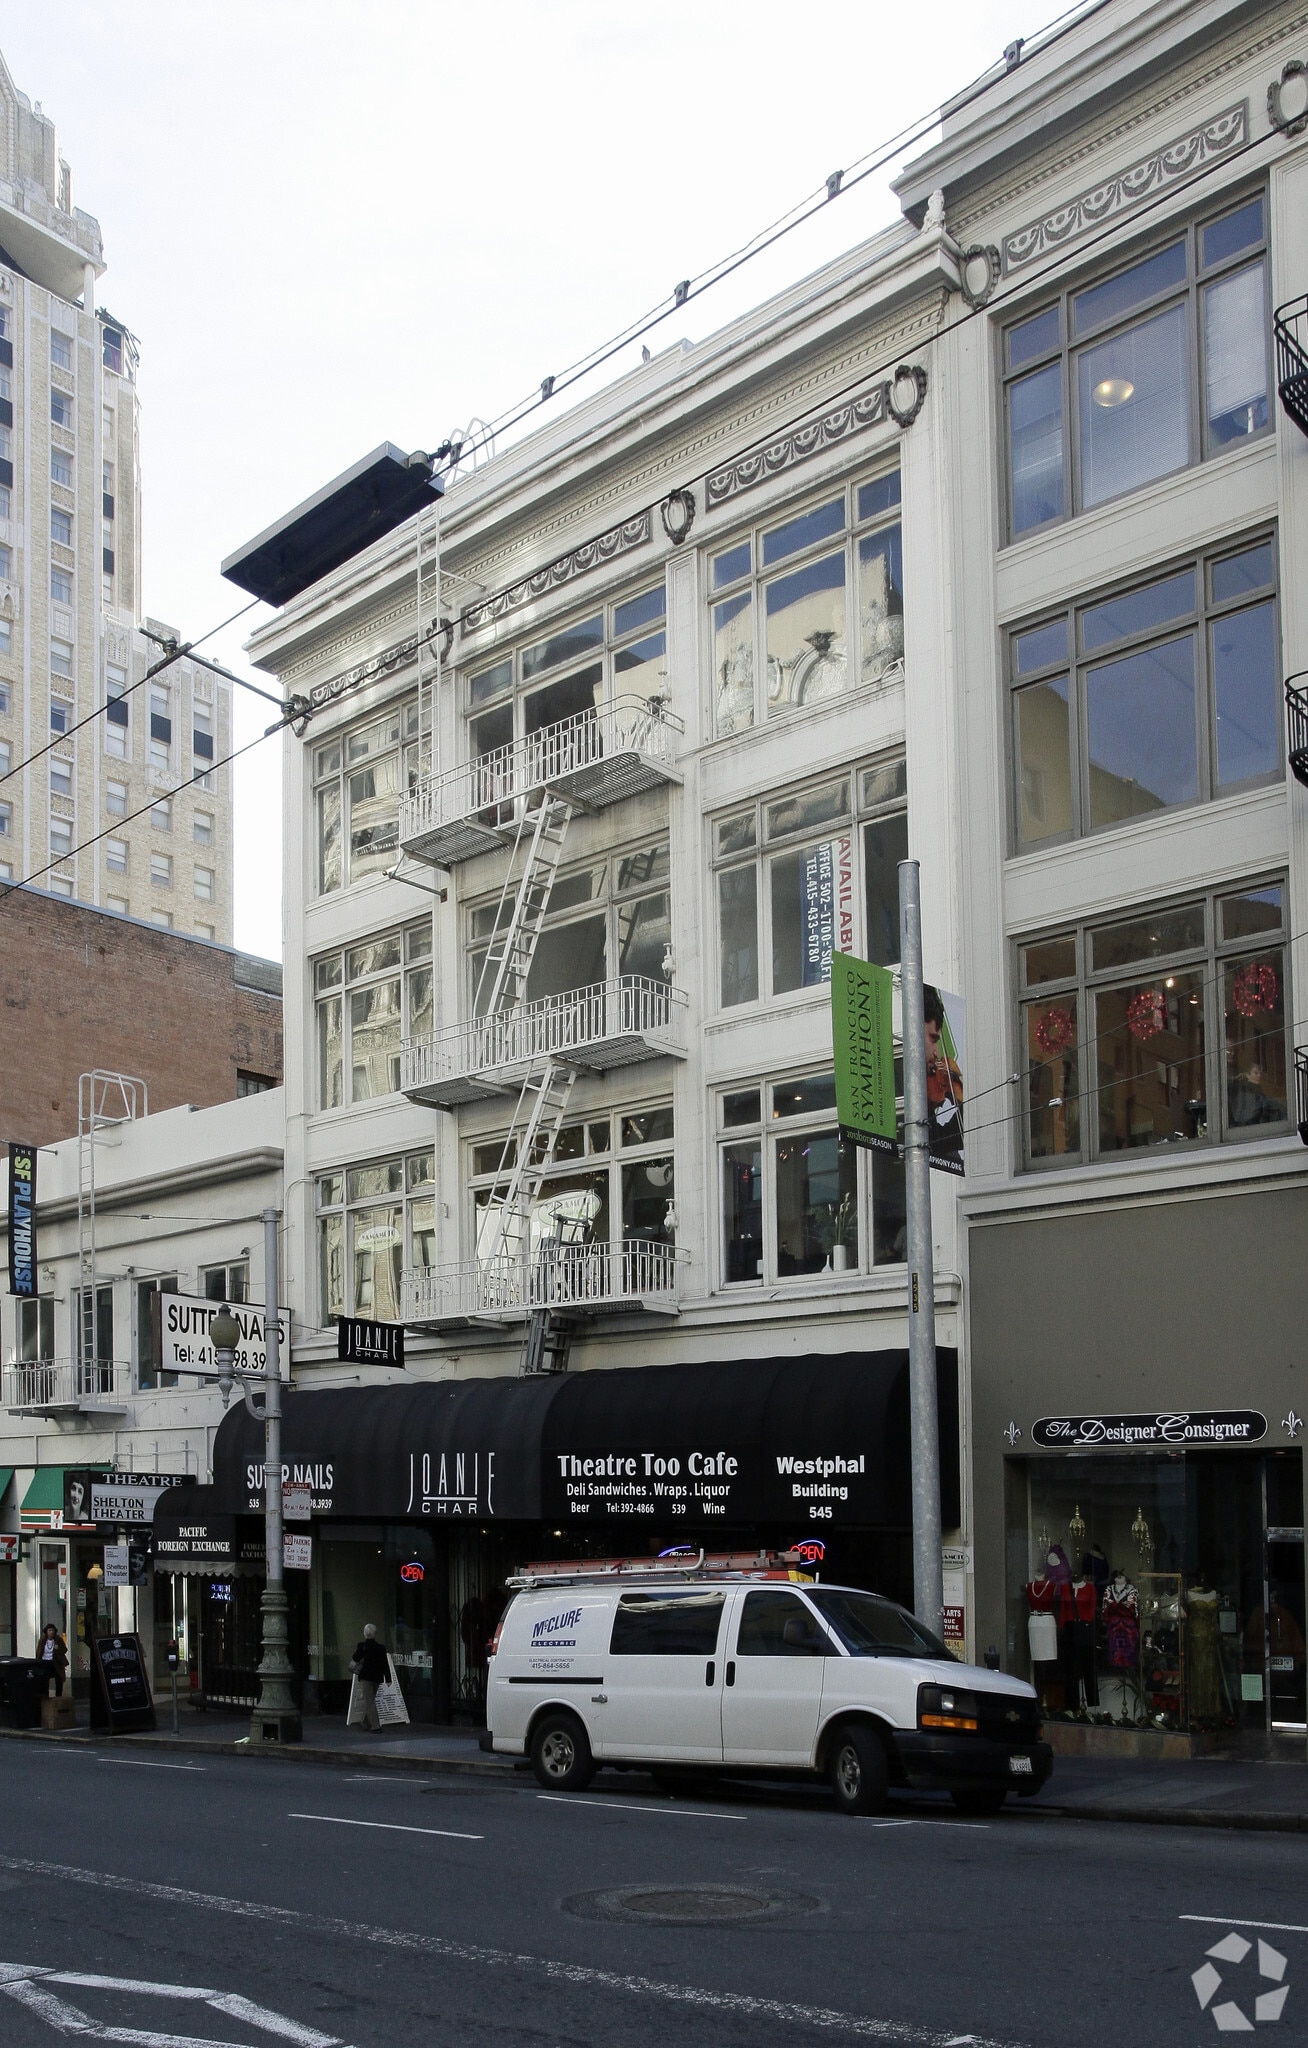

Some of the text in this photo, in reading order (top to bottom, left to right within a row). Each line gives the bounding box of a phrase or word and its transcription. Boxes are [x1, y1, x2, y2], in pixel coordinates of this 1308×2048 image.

[819, 843, 831, 880] OFFICE
[838, 838, 852, 954] AVAILABL
[846, 971, 861, 1119] SAN FRANCISCO
[857, 973, 875, 1125] SYMPHONY
[871, 1137, 892, 1151] SEASON
[15, 1147, 31, 1156] THE
[14, 1156, 33, 1294] SF PLAYHOUSE
[168, 1304, 219, 1337] SUTTE
[347, 1324, 398, 1361] JOANIE
[173, 1343, 195, 1364] Tel:
[355, 1350, 389, 1360] CHAR
[1045, 1414, 1250, 1445] The Designer Consigner
[557, 1451, 739, 1477] Theatre Too Cafe
[776, 1455, 865, 1478] Westphal
[102, 1473, 183, 1487] THEATRE
[293, 1464, 334, 1490] NAILS
[406, 1452, 496, 1515] JOANIE
[282, 1488, 291, 1496] NO
[566, 1482, 731, 1500] Deli Sandwiches Wraps Liquor
[792, 1484, 849, 1500] Building
[93, 1496, 144, 1509] SHELTON
[248, 1498, 260, 1508] 535
[421, 1502, 478, 1515] CHAR
[571, 1502, 726, 1515] Beer Tel: 392-4866 539 Wine
[93, 1508, 145, 1520] THEATER
[809, 1506, 833, 1519] 545
[178, 1526, 208, 1538] PACIFIC
[157, 1540, 231, 1553] FOREIGN EXCHANGE
[243, 1542, 266, 1551] FOREI
[284, 1535, 311, 1546] NO PARKING
[0, 1537, 17, 1560] 7
[106, 1563, 128, 1571] Shelton
[106, 1570, 128, 1578] Theater
[401, 1565, 425, 1581] OPEN
[946, 1609, 962, 1618] ARTS
